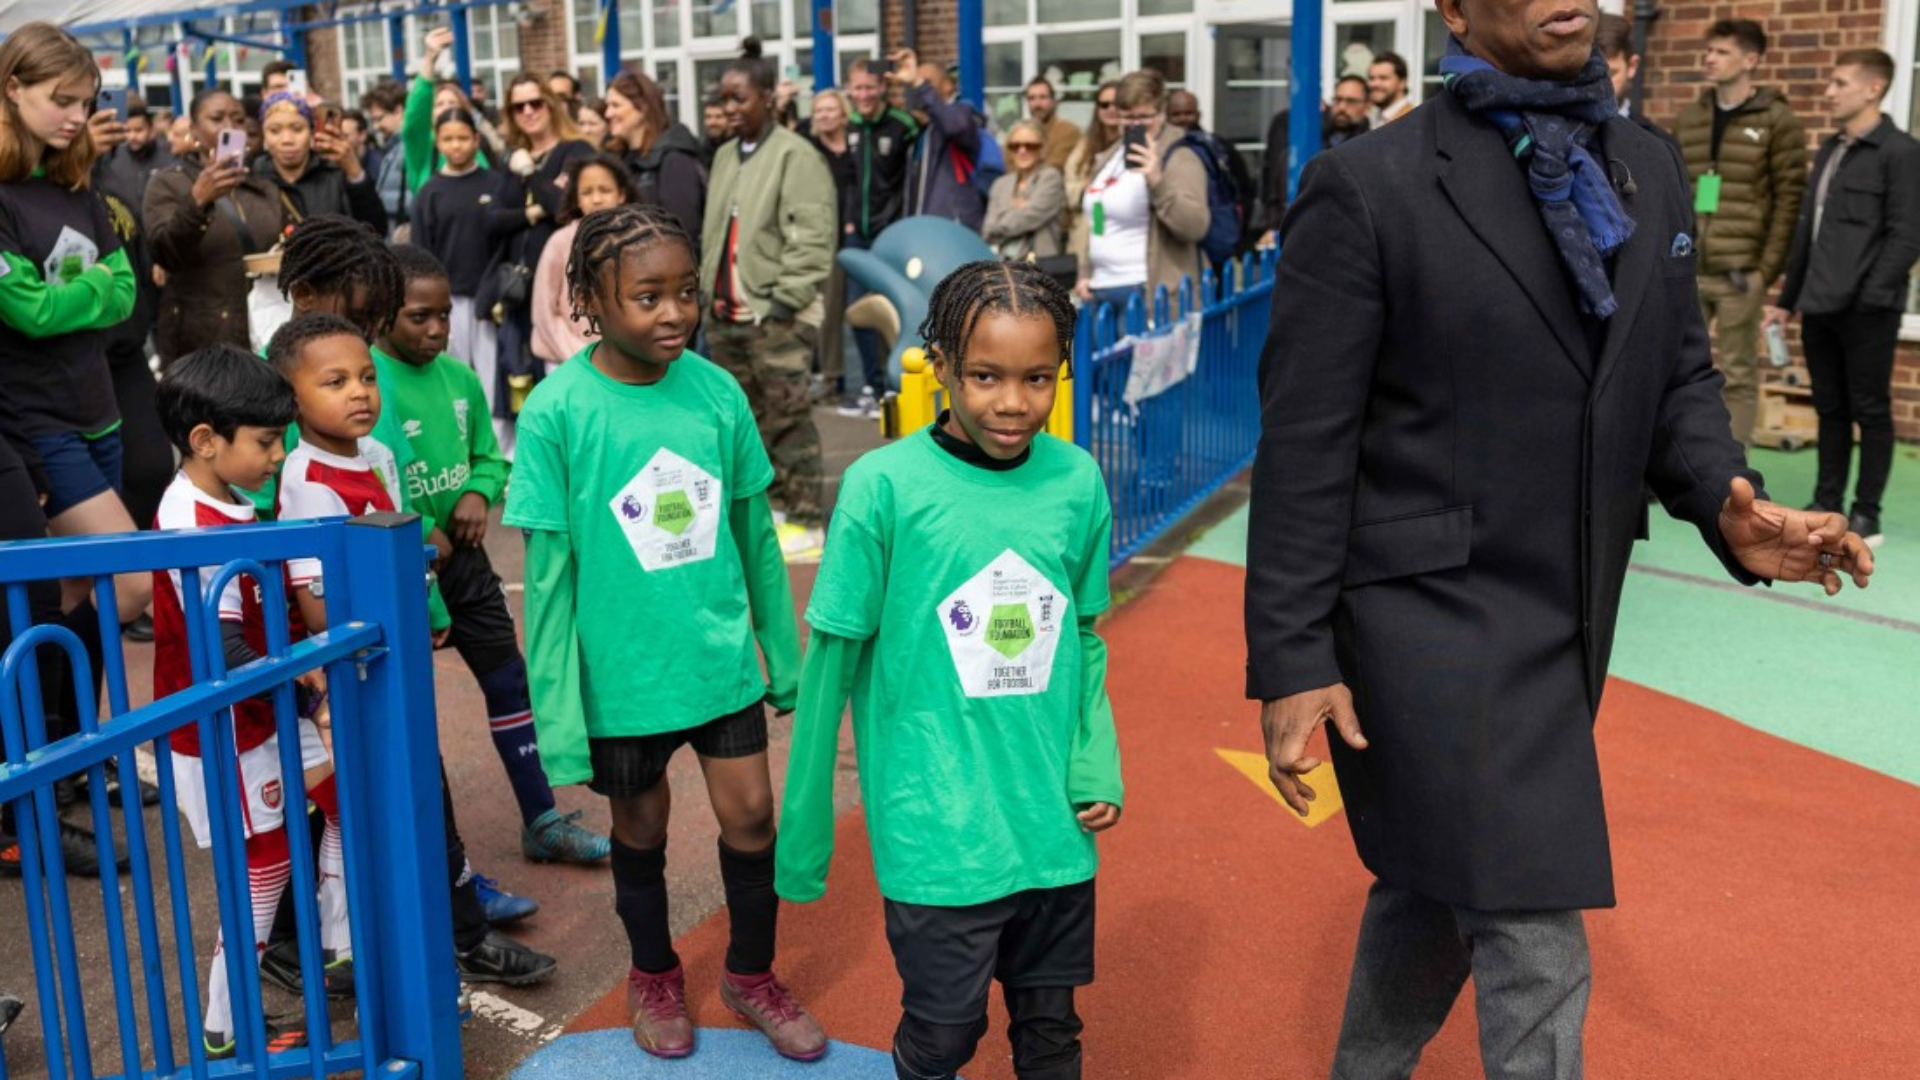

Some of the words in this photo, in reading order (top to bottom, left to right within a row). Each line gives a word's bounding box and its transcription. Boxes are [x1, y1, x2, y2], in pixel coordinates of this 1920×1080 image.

[994, 618, 1027, 629] FOOTBALL
[990, 629, 1031, 641] FOUNDATION
[994, 665, 1027, 678] TOGETHER
[987, 678, 1001, 690] FOR
[1002, 676, 1034, 689] FOOTBALL
